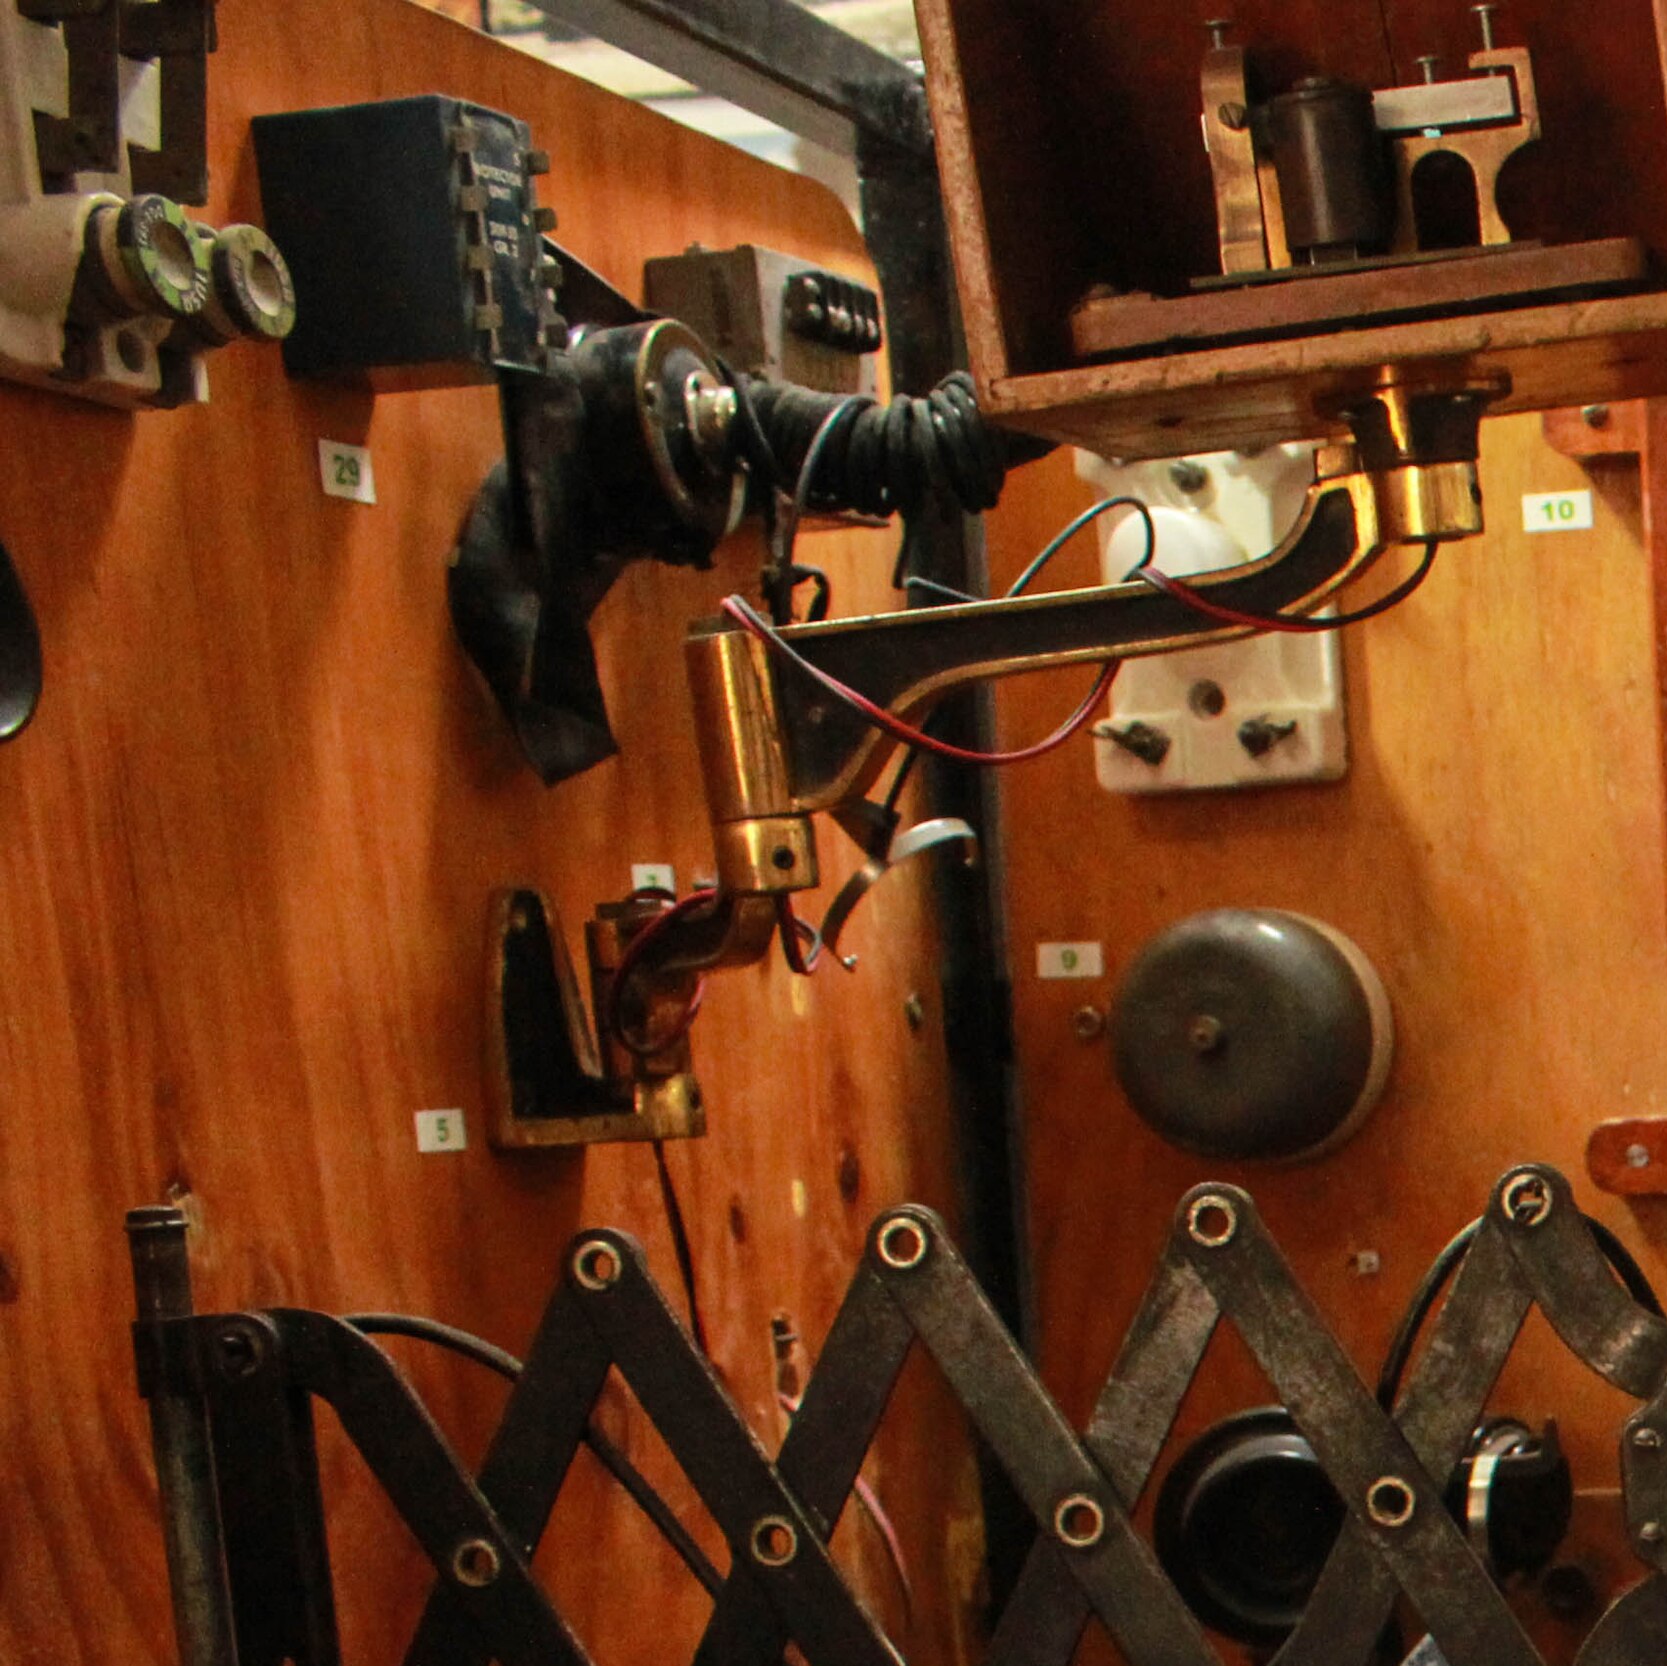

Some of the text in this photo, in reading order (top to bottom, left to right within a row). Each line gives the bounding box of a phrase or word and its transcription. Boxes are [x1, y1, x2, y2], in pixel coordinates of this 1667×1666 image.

[332, 454, 360, 487] 29
[1540, 500, 1575, 522] 10
[1061, 948, 1078, 972] 9
[436, 1117, 450, 1143] 5
